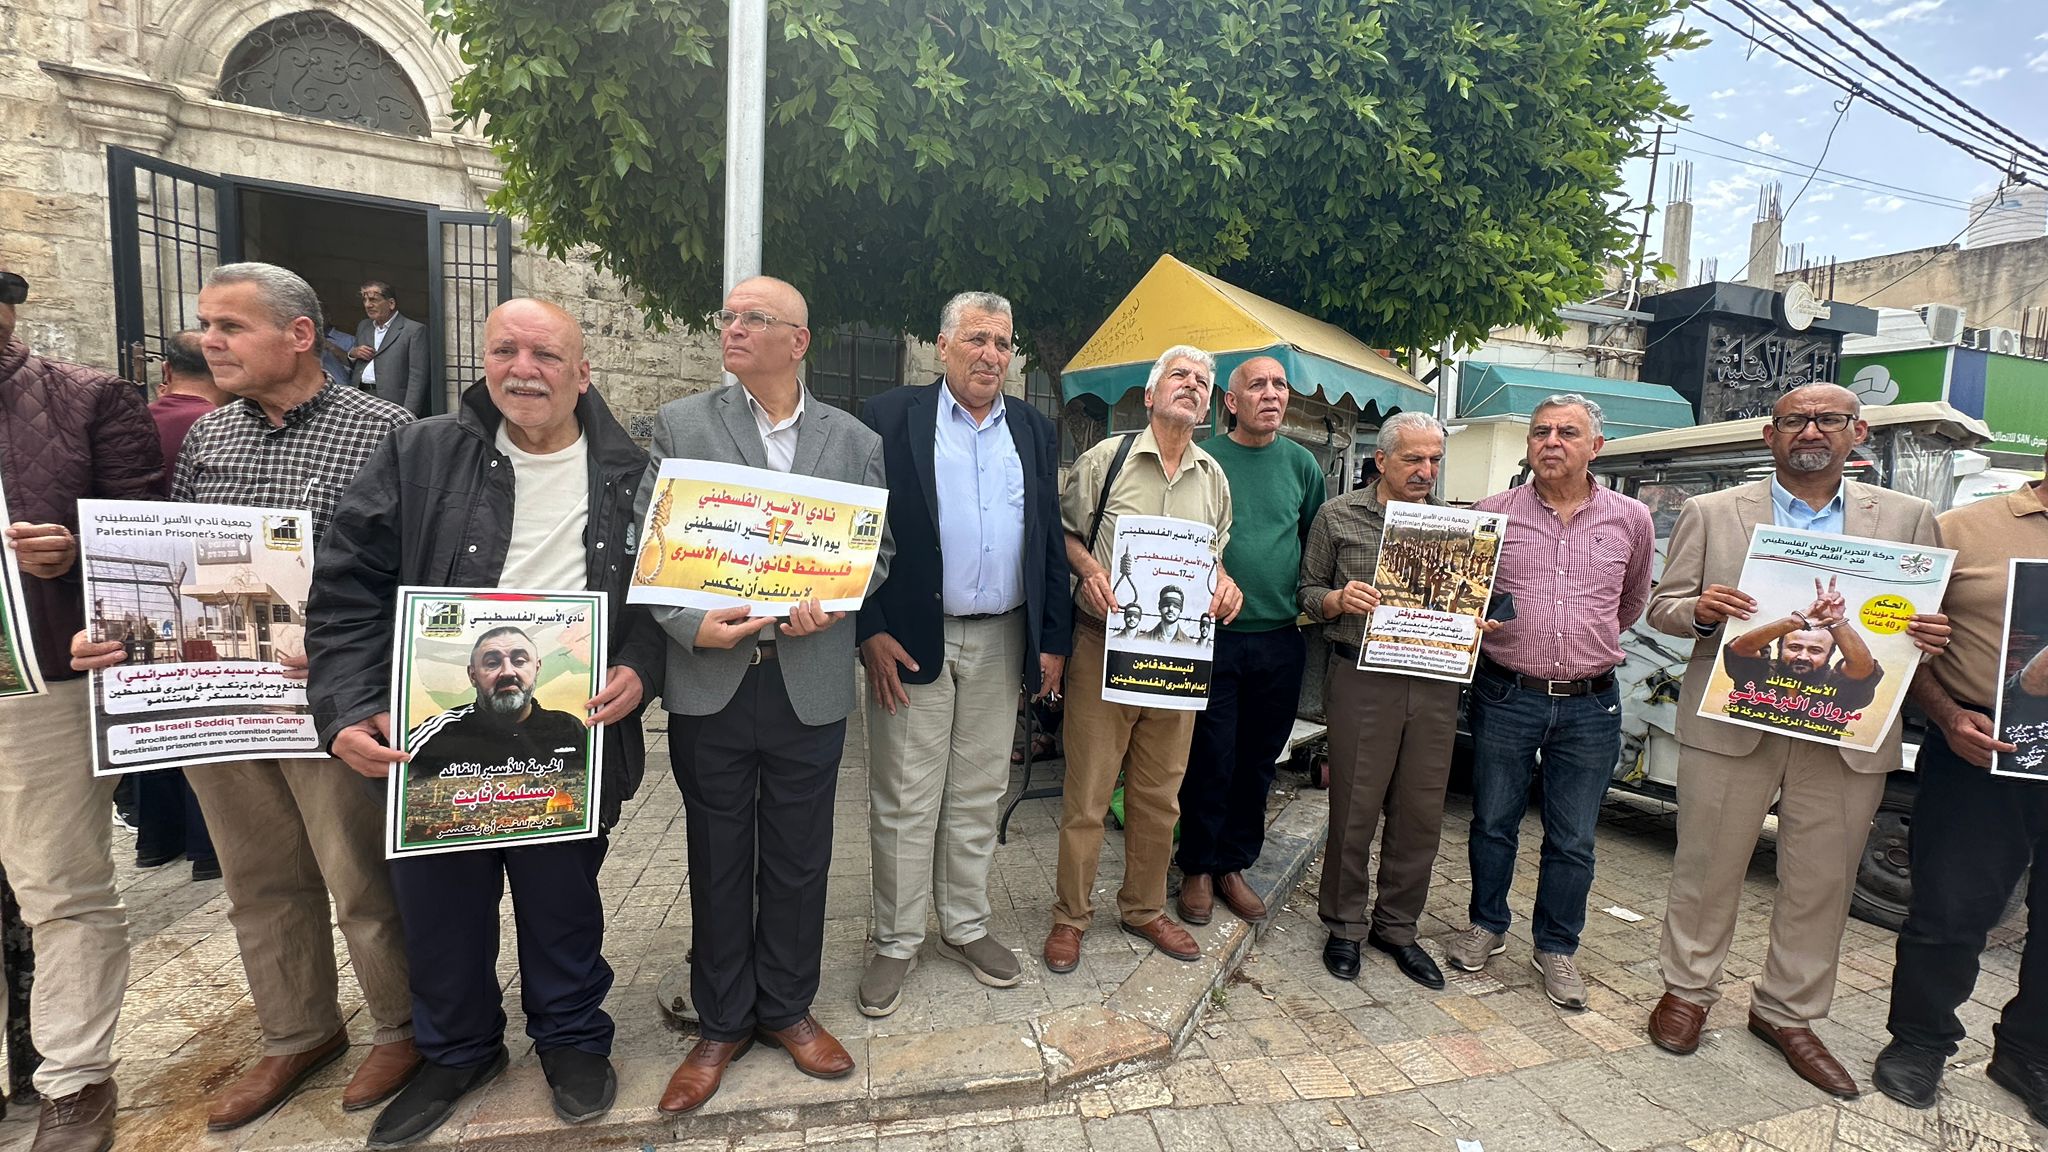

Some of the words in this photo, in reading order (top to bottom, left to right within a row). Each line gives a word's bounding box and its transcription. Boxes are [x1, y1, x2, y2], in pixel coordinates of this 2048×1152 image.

[2016, 433, 2030, 444] SAN
[699, 488, 762, 509] الفلسطيني
[761, 498, 805, 516] الأسير
[94, 513, 159, 523] الفلسطيني
[163, 514, 191, 525] الأسير
[195, 516, 219, 526] نادي
[220, 516, 252, 528] جمعية
[805, 506, 836, 525] نادي
[684, 516, 741, 534] الفلسطيني
[766, 516, 794, 546] 17
[1391, 518, 1420, 526] Palestinian
[1447, 525, 1469, 533] Society
[96, 527, 162, 537] Palestinian
[165, 529, 216, 539] Prisoner's
[218, 531, 253, 542] Society
[1119, 527, 1172, 539] الفلسطيني
[1172, 529, 1194, 541] الأسير
[1194, 534, 1206, 546] نادي
[824, 540, 841, 554] يوم
[1761, 536, 1808, 548] الفلسطيني
[1809, 542, 1843, 553] الوطني
[671, 538, 718, 561] الأسرى
[1784, 547, 1818, 558] طولكرم
[1843, 548, 1871, 557] التحرير
[1872, 550, 1895, 560] حركة
[718, 548, 755, 575] إعدام
[754, 553, 791, 574] قانون
[1134, 551, 1183, 563] الفلسطيني
[1183, 556, 1202, 566] الأسير
[792, 559, 852, 581] فليسقط
[700, 576, 744, 596] ينكسر
[745, 576, 759, 597] أن
[759, 583, 790, 601] للقيد
[803, 587, 813, 597] لا
[789, 590, 803, 601] بد
[1874, 599, 1907, 610] الحكم
[469, 610, 536, 629] الفلسطيني
[536, 609, 565, 625] الأسير
[566, 612, 585, 629] نادي
[1863, 608, 1888, 619] مؤبدات
[1132, 658, 1158, 670] قانون
[1157, 661, 1195, 675] فليسقط
[190, 666, 221, 678] تيمان
[255, 667, 284, 677] سكر
[216, 681, 248, 691] ترتكب
[250, 681, 281, 691] وجرائم
[282, 681, 307, 691] ظائع
[1165, 678, 1191, 690] الأسرى
[1765, 675, 1801, 689] القائد
[109, 684, 162, 698] فلسطين
[206, 692, 249, 701] معسكر
[250, 692, 264, 700] من
[1728, 680, 1810, 713] البرغوثي
[1801, 684, 1837, 697] الأسير
[1722, 703, 1739, 713] فتح
[1740, 706, 1766, 719] لحركة
[1808, 700, 1863, 724] مروان
[127, 725, 151, 735] The
[154, 721, 192, 732] Israeli
[194, 718, 235, 729] Seddiq
[236, 717, 274, 726] Teiman
[276, 716, 306, 726] Camp
[1768, 711, 1803, 727] المركزية
[1803, 719, 1833, 733] اللجنة
[135, 734, 178, 745] atrocities
[198, 731, 227, 739] crimes
[229, 728, 270, 736] committed
[1832, 727, 1855, 737] عضو
[113, 745, 164, 756] Palestinian
[165, 740, 208, 751] prisoners
[251, 735, 268, 743] than
[269, 735, 316, 743] Guantanamo
[439, 762, 481, 778] القائد
[481, 757, 525, 779] للأسير
[526, 757, 564, 778] الحرية
[453, 781, 493, 810] ثابت
[494, 782, 556, 803] مسلمة
